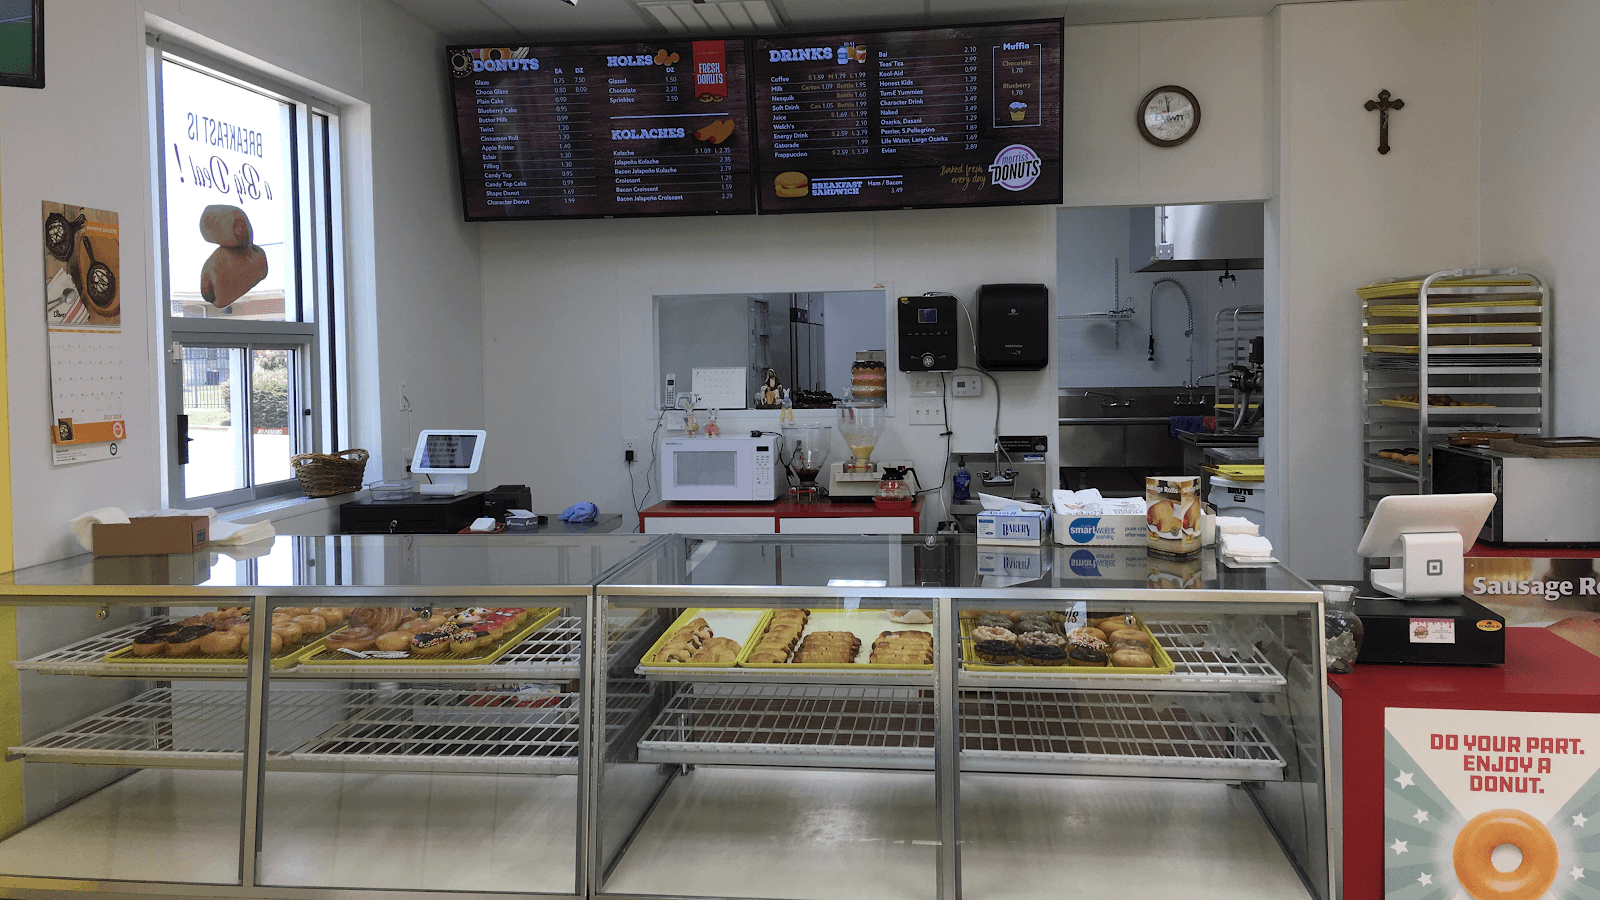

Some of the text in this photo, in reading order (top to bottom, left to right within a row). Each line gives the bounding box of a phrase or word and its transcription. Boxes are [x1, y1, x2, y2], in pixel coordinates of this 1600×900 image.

[1003, 42, 1030, 51] Muffin
[607, 55, 653, 67] HOLES
[769, 47, 833, 63] DRINKS
[472, 58, 539, 72] DONUTS
[698, 62, 720, 74] FRESH
[697, 73, 723, 85] DONUTS
[477, 107, 504, 115] Blueberry
[611, 128, 685, 140] KOLACHES
[775, 151, 808, 159] Frappuccino
[990, 160, 1040, 182] DONUTS
[812, 181, 863, 189] BREAKFAST
[951, 175, 986, 191] every day
[812, 188, 860, 196] SANDWICH
[1228, 487, 1253, 495] BRUTE
[1003, 523, 1031, 536] BAKERY
[1473, 577, 1600, 601] Sausage R
[1430, 734, 1585, 755] DO YOUR PART.
[1463, 755, 1551, 774] ENJOY A
[1470, 775, 1545, 794] DONUT.
